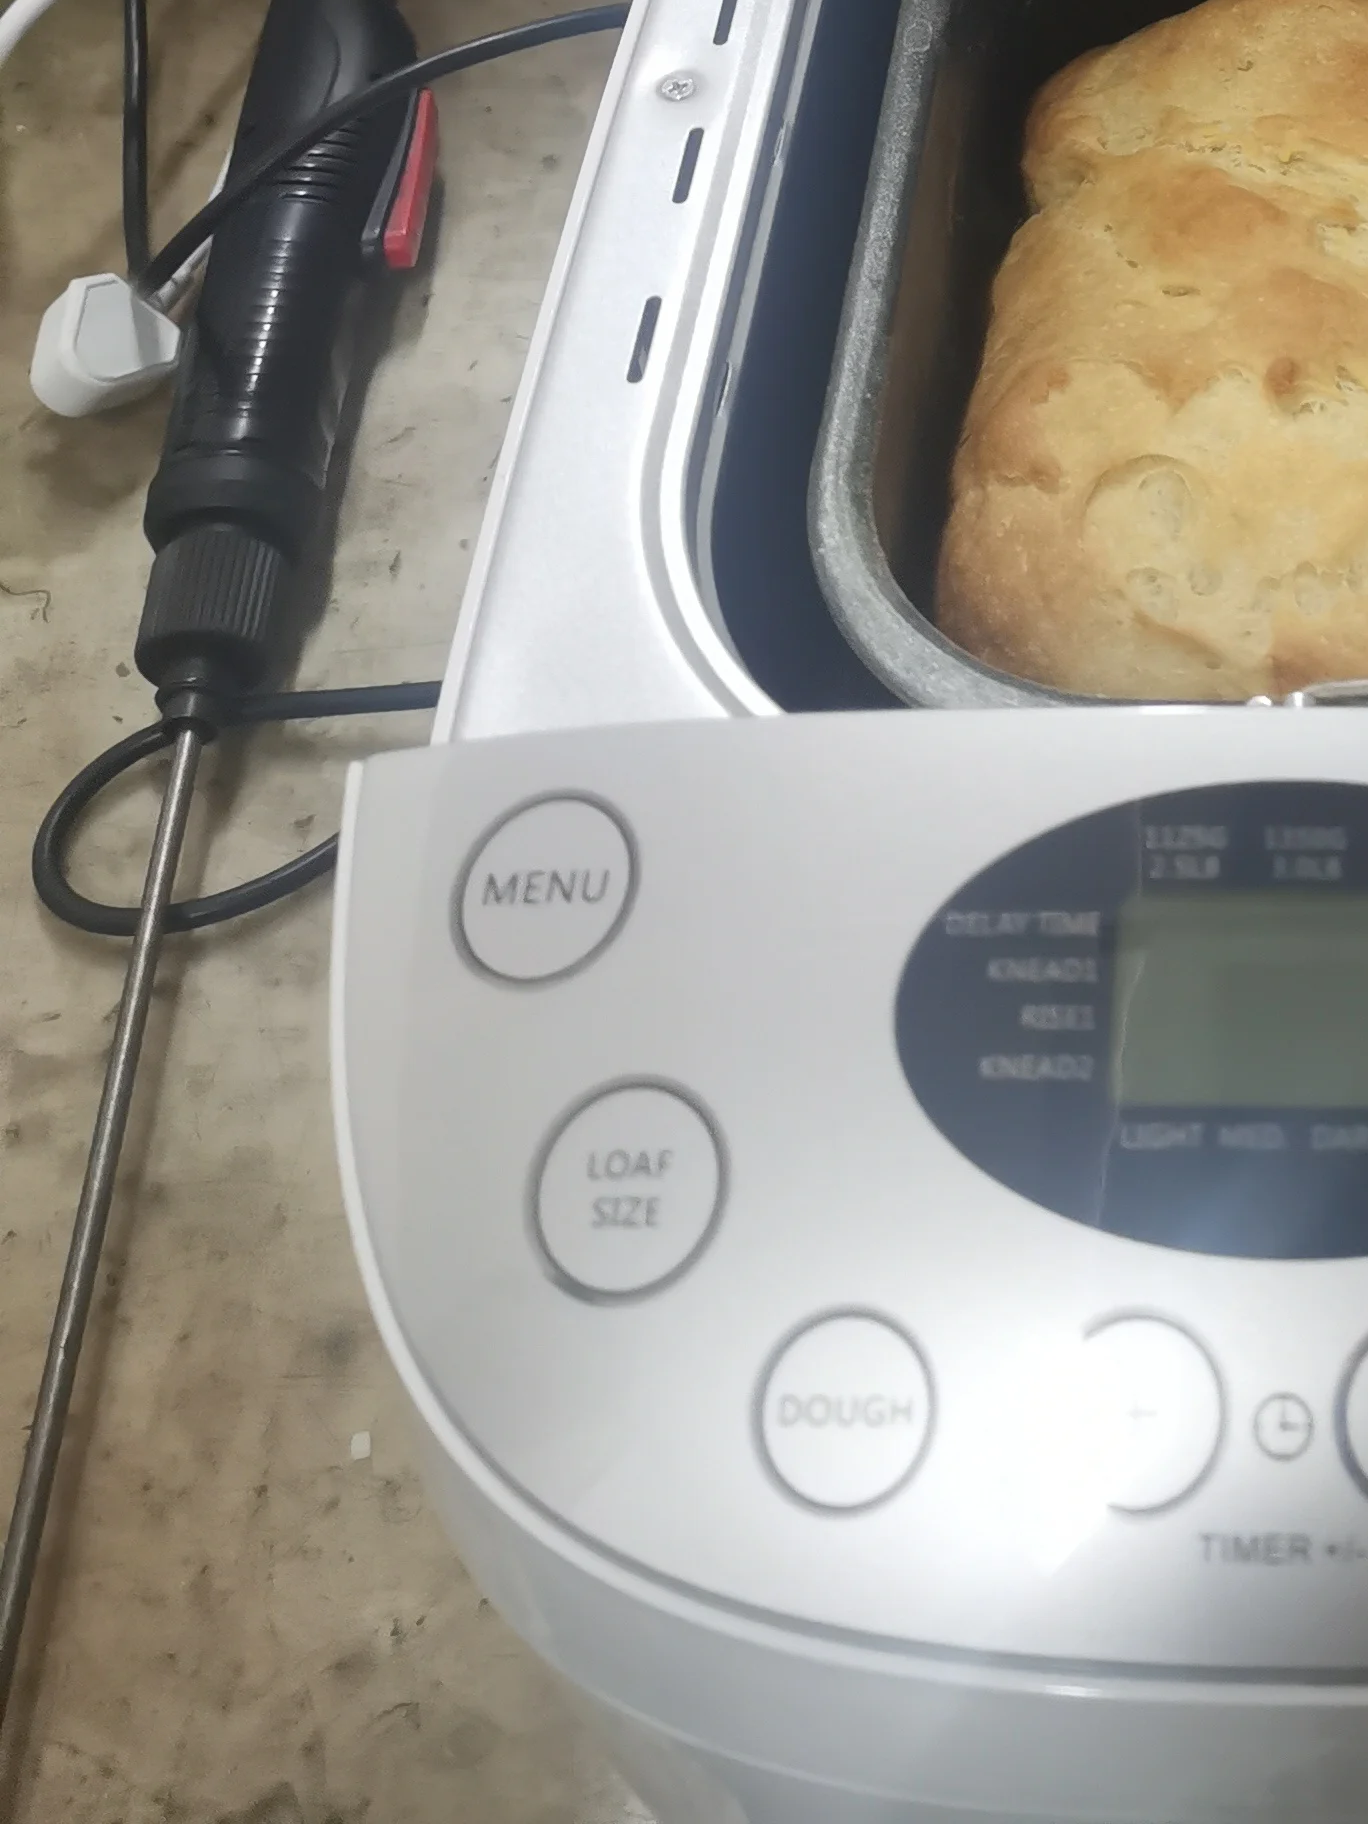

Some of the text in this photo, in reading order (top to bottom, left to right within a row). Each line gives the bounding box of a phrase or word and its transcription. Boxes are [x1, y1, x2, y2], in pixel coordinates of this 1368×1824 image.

[482, 868, 611, 906] MENU
[1038, 911, 1101, 937] TIME
[587, 1148, 675, 1181] LOAF
[591, 1196, 663, 1229] SIZE
[777, 1393, 913, 1429] DOUGH
[1199, 1532, 1313, 1565] TIMER
